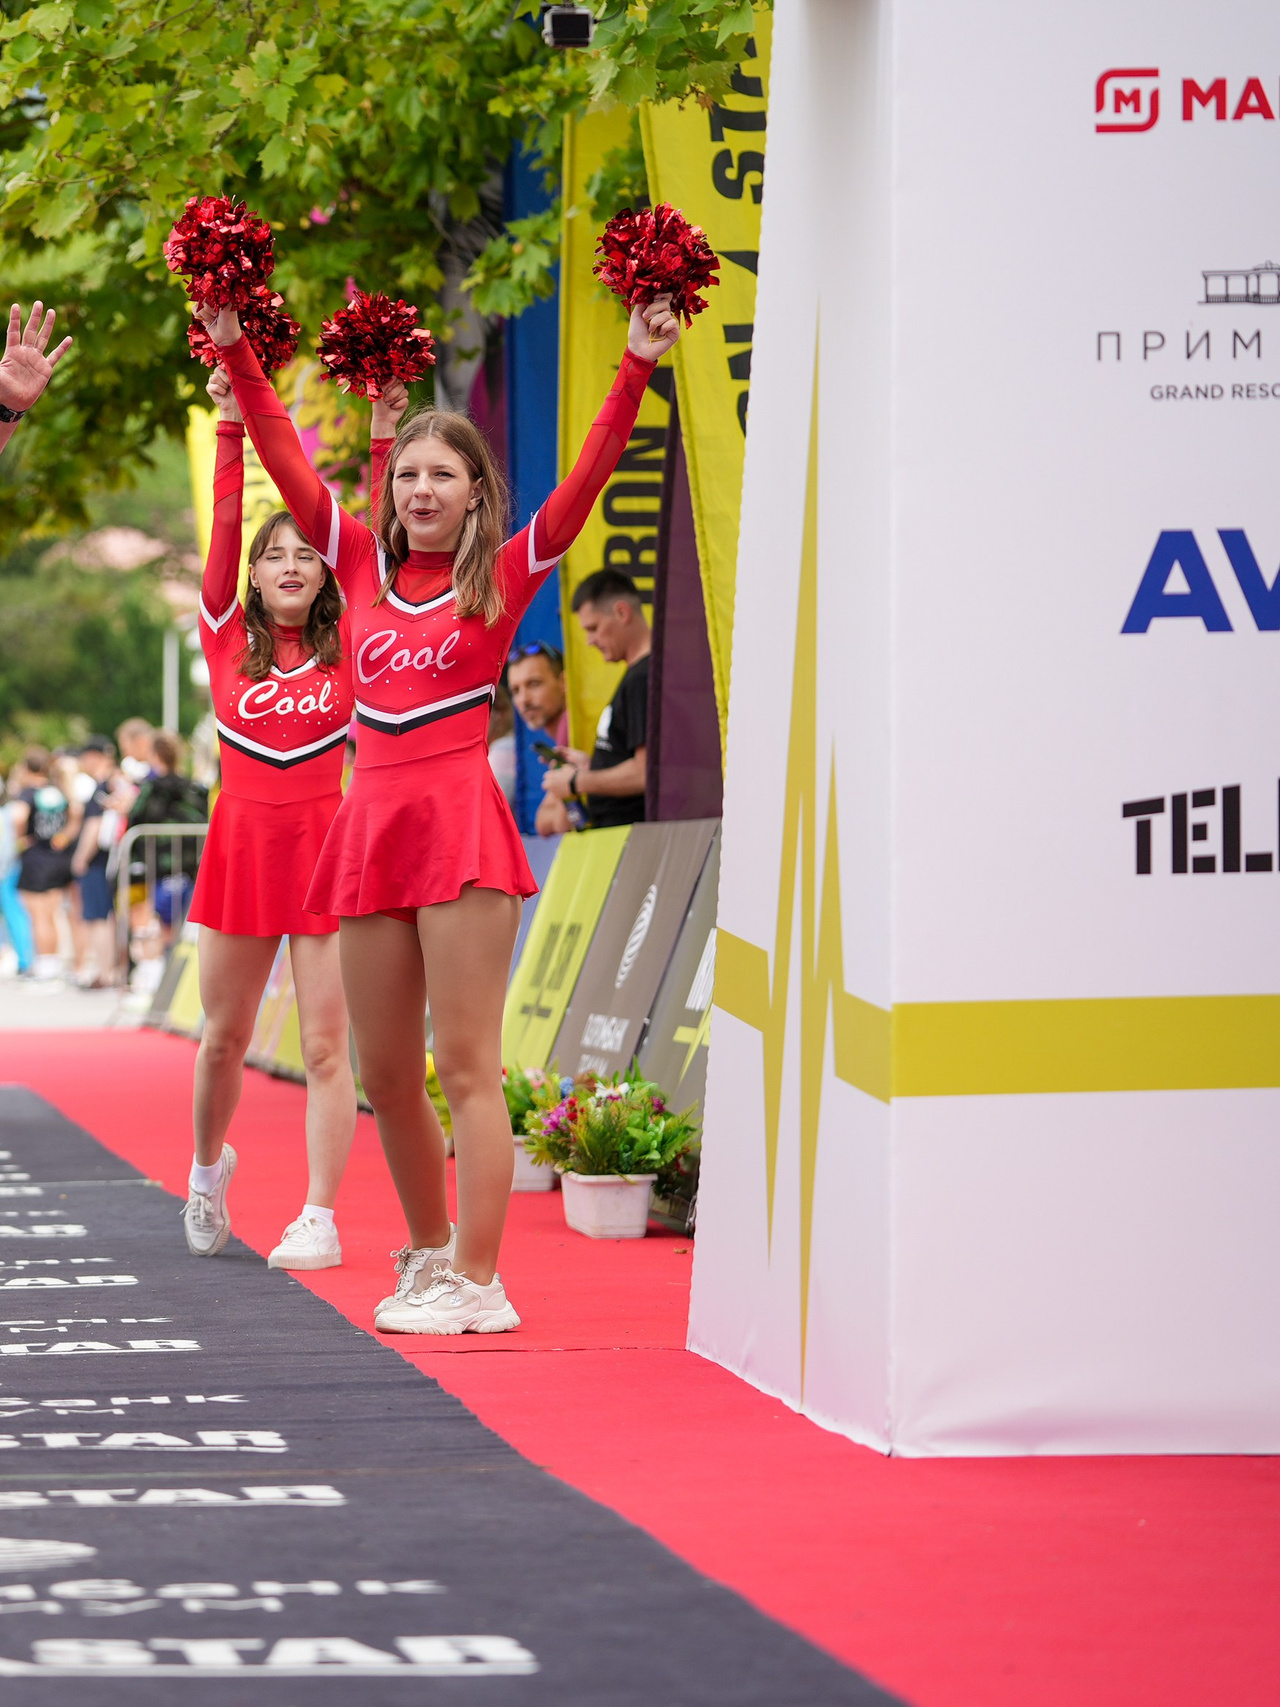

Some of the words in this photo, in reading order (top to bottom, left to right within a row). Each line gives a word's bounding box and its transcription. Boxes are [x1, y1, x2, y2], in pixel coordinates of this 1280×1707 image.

[1181, 76, 1280, 121] МА
[1096, 328, 1262, 361] ПРИМ
[1150, 384, 1224, 400] GRAND
[603, 426, 667, 604] RON
[356, 629, 461, 684] Cool
[237, 680, 333, 719] Cool
[1122, 777, 1280, 875] TEL
[30, 1634, 538, 1668] STAR
